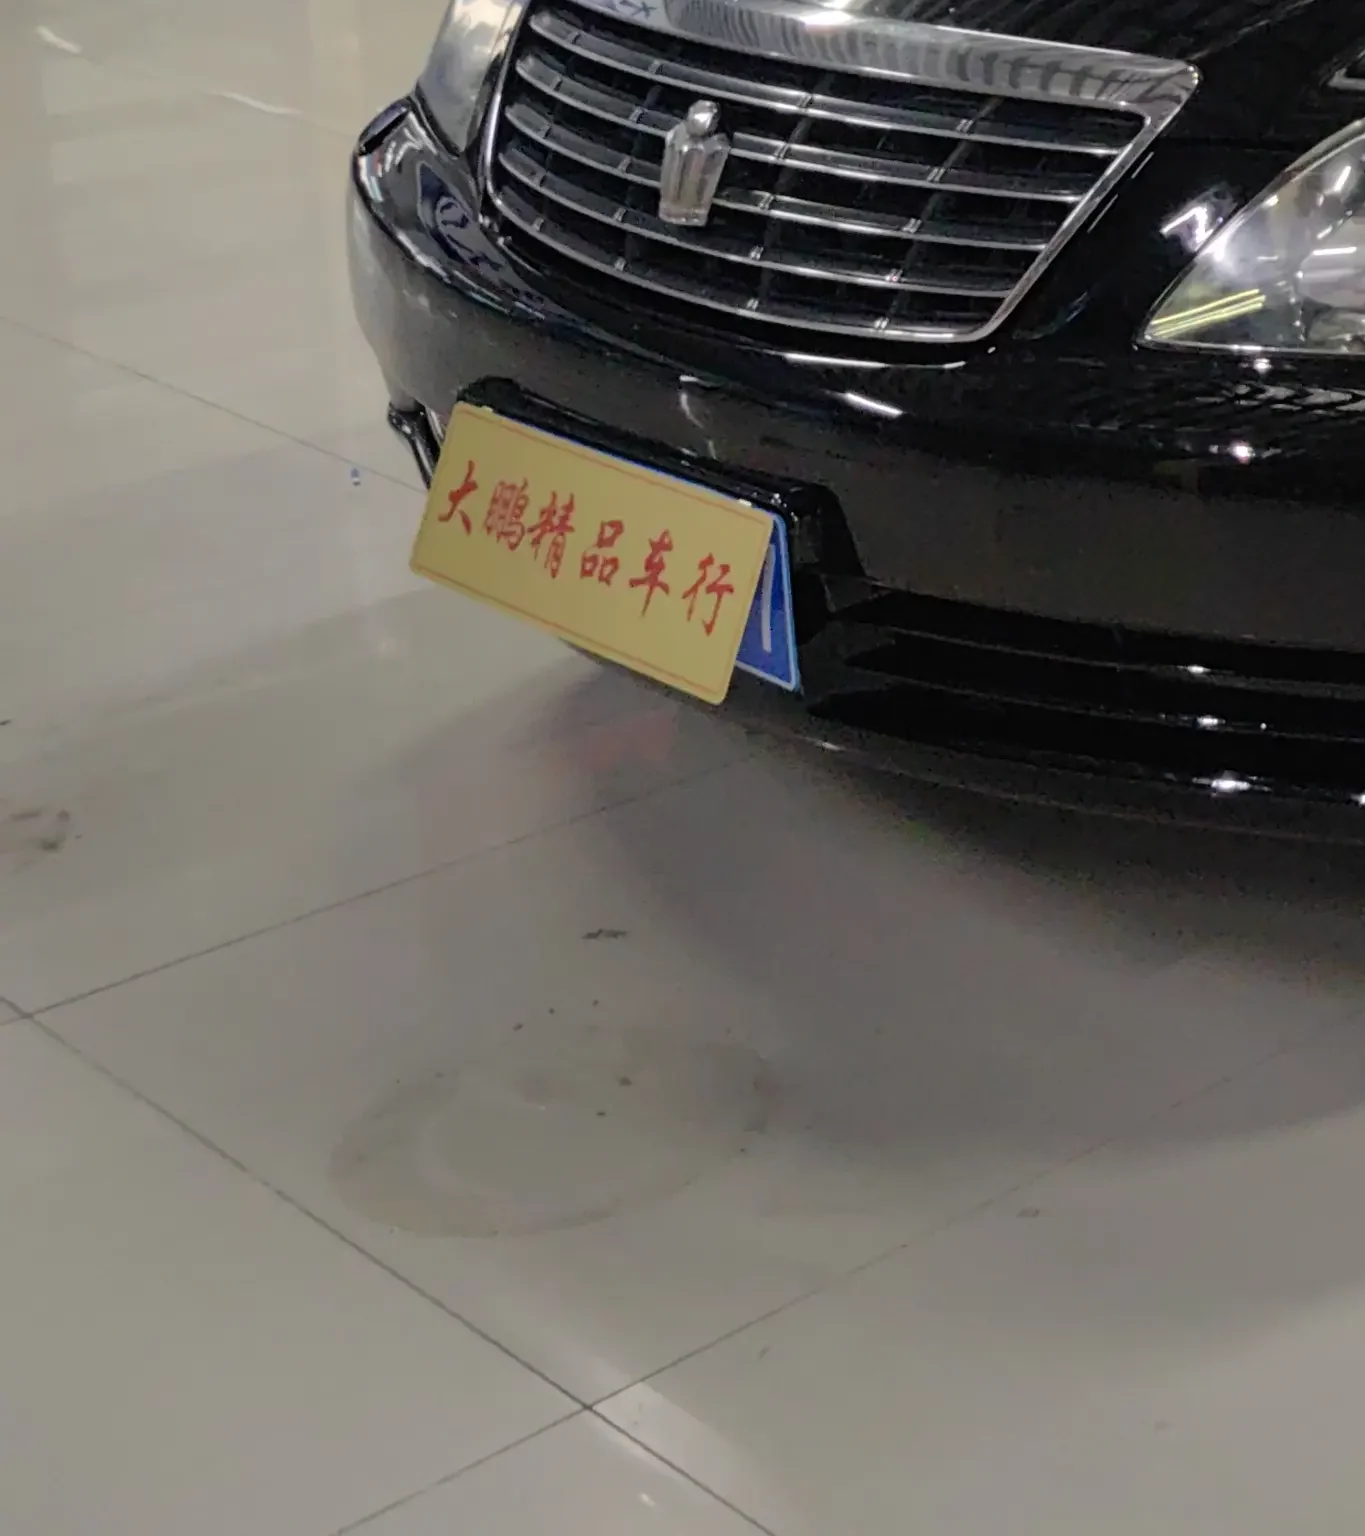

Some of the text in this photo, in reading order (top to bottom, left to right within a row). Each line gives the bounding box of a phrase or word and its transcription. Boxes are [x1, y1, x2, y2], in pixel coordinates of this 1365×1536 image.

[437, 459, 735, 638] 大鹏精品车行
